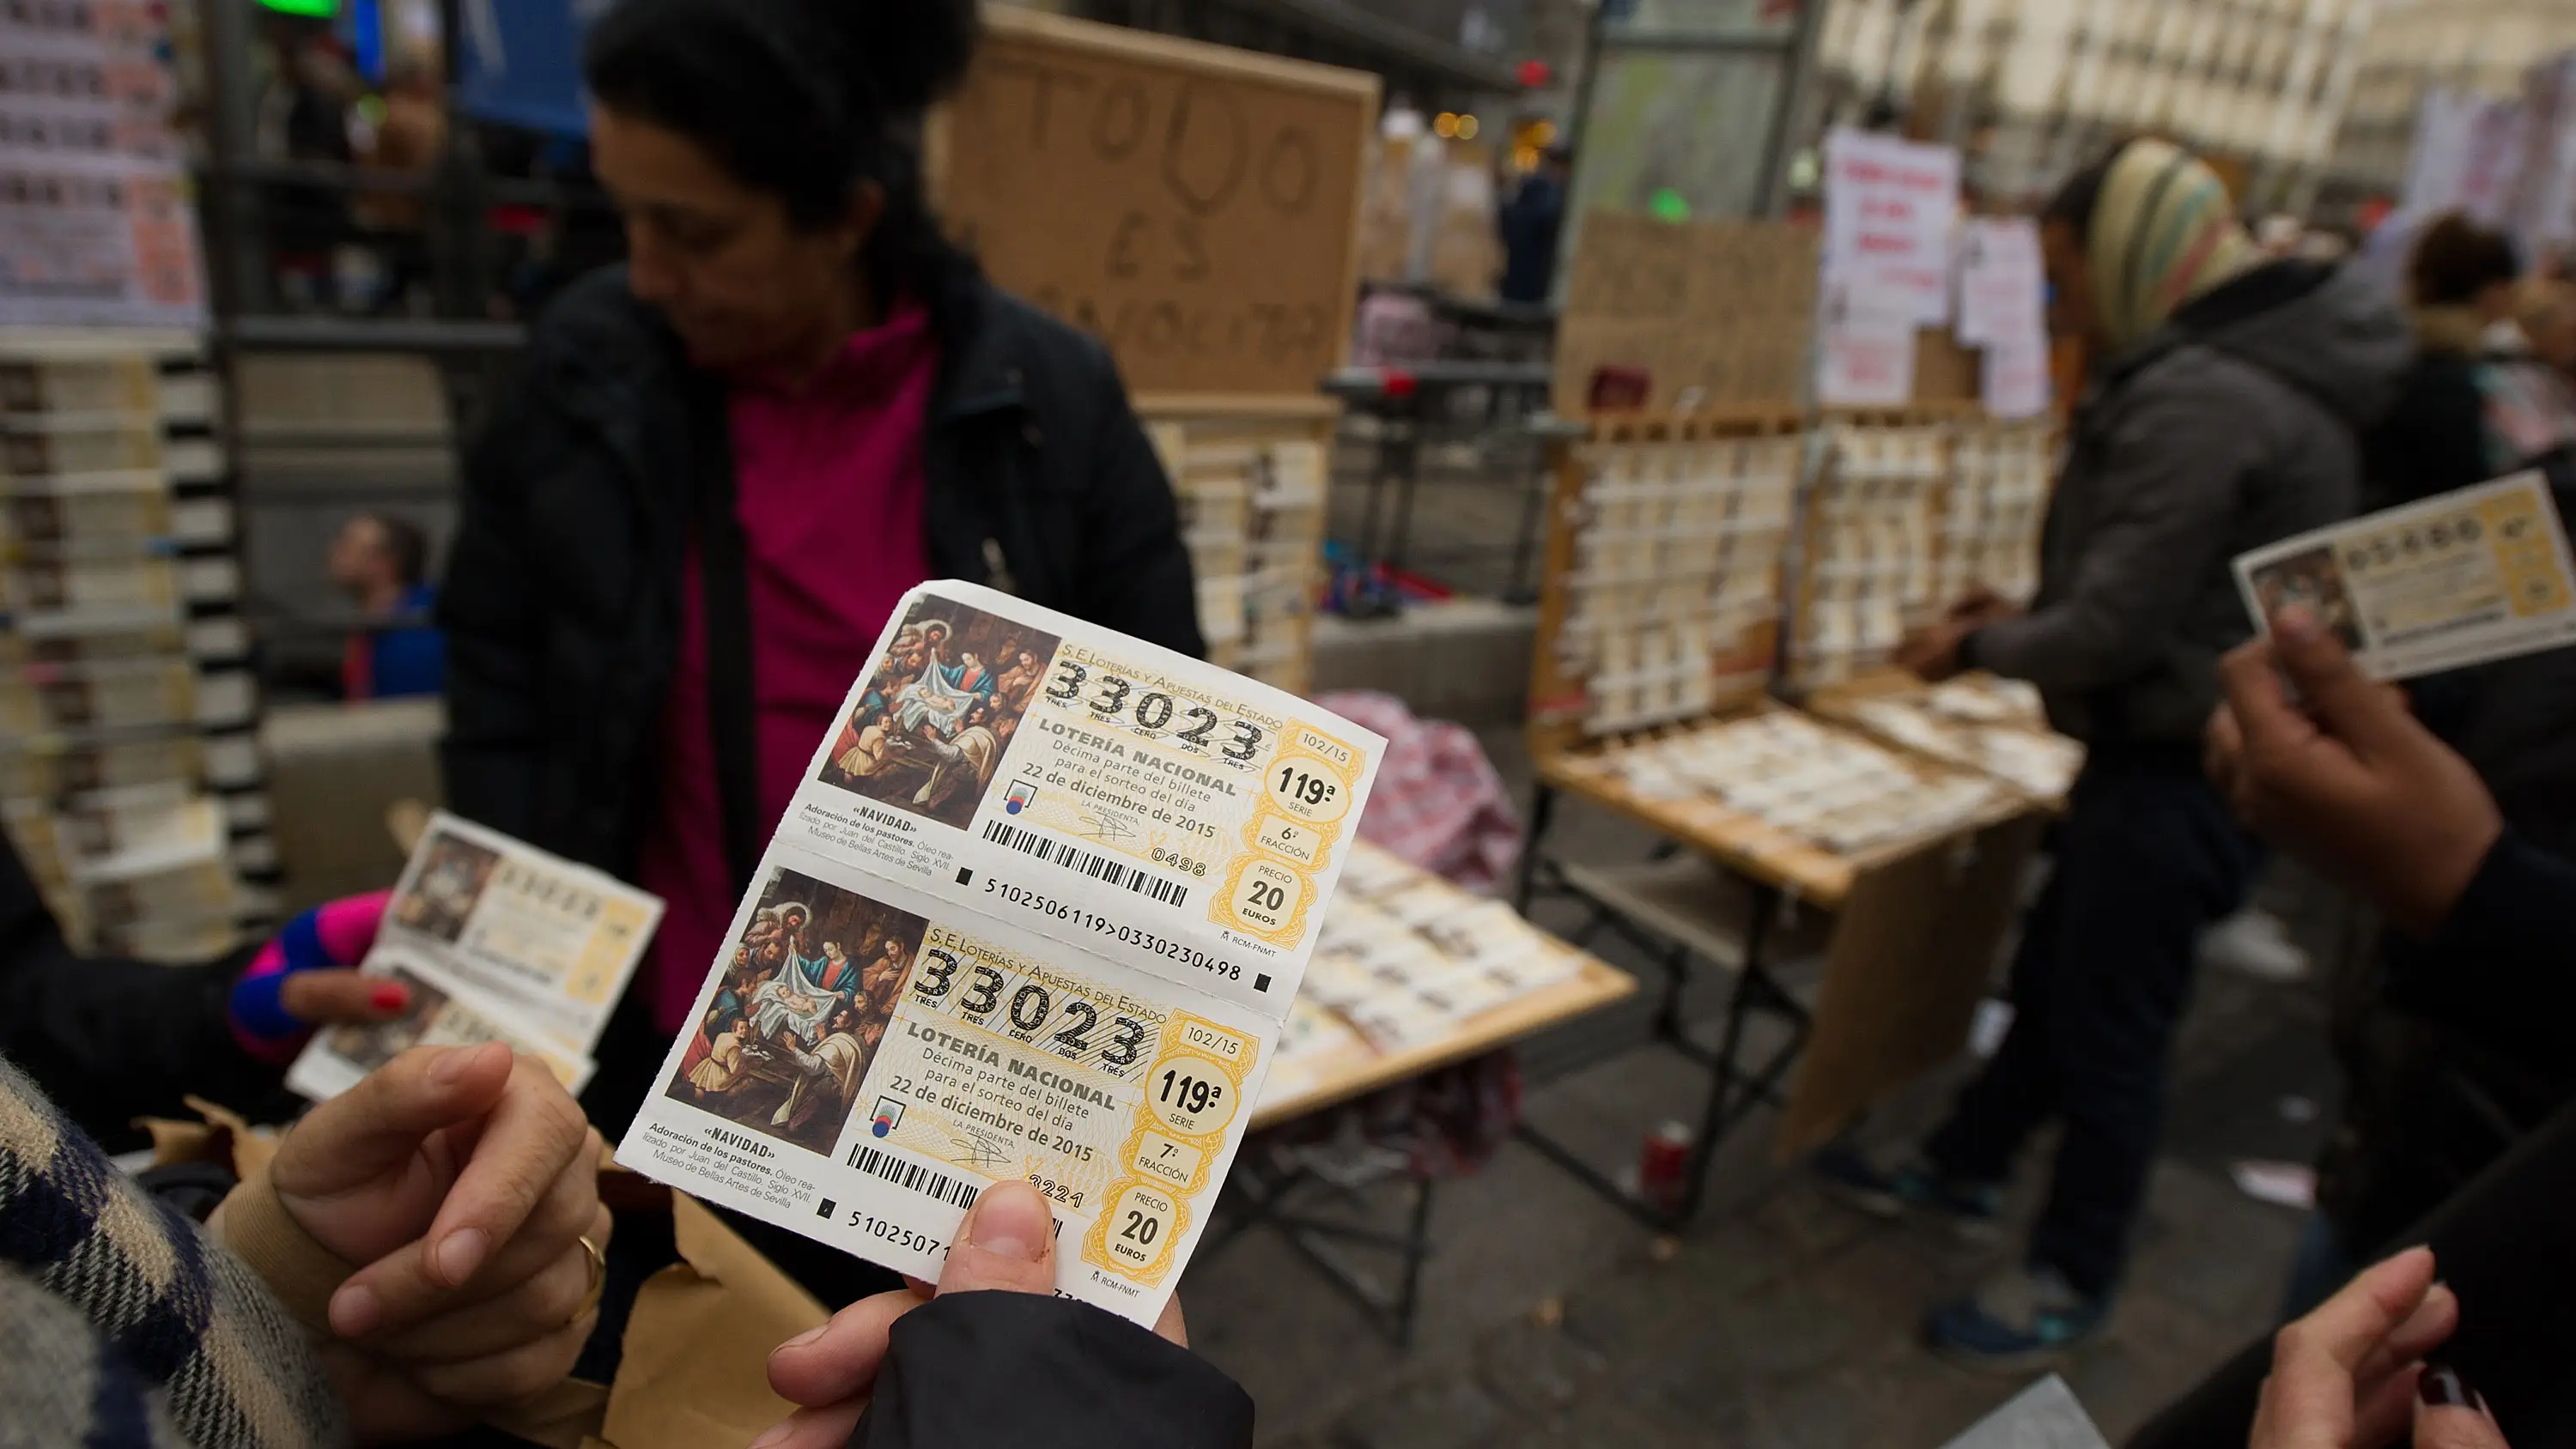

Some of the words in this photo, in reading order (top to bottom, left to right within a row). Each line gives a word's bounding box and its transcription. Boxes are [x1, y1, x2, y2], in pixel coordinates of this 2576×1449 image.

[1045, 660, 1261, 761] 33023
[1144, 673, 1151, 682] Y
[1151, 676, 1212, 705] APUESTAS
[1214, 699, 1233, 712] DEL
[1236, 703, 1283, 729] ESTADO
[1038, 718, 1124, 757] LOTERÍA
[1132, 750, 1236, 796] NACIONAL
[1042, 694, 1068, 709] TRES
[1087, 710, 1112, 724] TRES
[1133, 725, 1157, 740] CERO
[1180, 743, 1200, 754] DOS
[1221, 756, 1246, 770] TRES
[1303, 733, 1347, 761] 102/15
[1052, 739, 1100, 763] Décima
[1103, 758, 1139, 777] parte
[1143, 771, 1165, 785] del
[1168, 779, 1210, 802] billete
[1054, 758, 1084, 773] para
[1089, 768, 1102, 779] el
[1103, 774, 1145, 794] sorteo
[1150, 789, 1171, 803] del
[1175, 797, 1194, 811] día
[1022, 762, 1042, 778] 22
[1046, 771, 1066, 786] de
[1070, 779, 1146, 814] diciembre
[1151, 807, 1171, 822] de
[1175, 815, 1215, 837] 2015
[1080, 799, 1090, 808] LA
[1288, 801, 1312, 816] SERIE
[804, 803, 848, 823] Adoración
[849, 819, 860, 828] de
[861, 822, 875, 833] los
[875, 829, 915, 846] pastores.
[917, 840, 937, 854] Óleo
[807, 825, 835, 841] Museo
[836, 836, 847, 846] de
[848, 839, 872, 854] Bellas
[872, 848, 894, 862] Artes
[894, 857, 905, 866] de
[906, 860, 932, 876] Sevilla
[822, 822, 837, 830] por
[839, 826, 859, 838] Juan
[861, 834, 875, 844] del
[909, 850, 929, 864] Siglo
[1260, 835, 1309, 860] FRACCIÓN
[1151, 846, 1206, 876] 0498
[1258, 864, 1291, 883] PRECIO
[1242, 907, 1276, 925] EUROS
[1247, 880, 1284, 910] 20
[914, 948, 1148, 1066] 33023
[1018, 962, 1026, 973] Y
[1027, 965, 1091, 997] APUESTAS
[1094, 991, 1113, 1007] DEL
[1116, 995, 1166, 1023] ESTADO
[913, 993, 939, 1009] TRES
[959, 1010, 986, 1027] TRES
[1007, 1028, 1033, 1044] CERO
[1057, 1046, 1078, 1060] DOS
[1100, 1062, 1126, 1078] TRES
[1188, 1027, 1238, 1054] 102/15
[907, 1022, 999, 1067] LOTERÍA
[1006, 1058, 1115, 1111] NACIONAL
[922, 1046, 973, 1075] Décima
[975, 1070, 1015, 1090] parte
[1019, 1083, 1042, 1100] del
[1044, 1091, 1088, 1119] billete
[890, 1075, 911, 1094] 22
[914, 1085, 936, 1103] de
[940, 1094, 1023, 1135] diciembre
[1027, 1126, 1048, 1145] de
[1051, 1135, 1093, 1161] 2015
[924, 1069, 957, 1087] para
[961, 1082, 975, 1094] el
[977, 1088, 1022, 1111] sorteo
[1026, 1105, 1048, 1121] del
[1051, 1114, 1072, 1131] día
[952, 1119, 963, 1128] LA
[1169, 1113, 1194, 1130] SERIE
[641, 1131, 667, 1148] lizado
[669, 1144, 686, 1155] por
[688, 1150, 709, 1164] Juan
[713, 1160, 728, 1171] del
[767, 1179, 788, 1194] Siglo
[648, 1123, 698, 1147] Adoración
[700, 1142, 712, 1152] de
[714, 1146, 728, 1158] los
[728, 1154, 772, 1175] pastores.
[775, 1167, 796, 1184] Óleo
[653, 1149, 684, 1167] Museo
[684, 1162, 696, 1173] de
[697, 1166, 724, 1183] Bellas
[724, 1177, 749, 1192] Artes
[750, 1186, 762, 1197] de
[762, 1191, 791, 1208] Sevilla
[1138, 1156, 1188, 1182] FRACCIÓN
[1133, 1191, 1167, 1211] PRECIO
[848, 1210, 951, 1261] 51025071
[1115, 1243, 1146, 1261] EUROS
[1120, 1210, 1157, 1245] 20
[1100, 1276, 1139, 1297] RCM-FNMT
